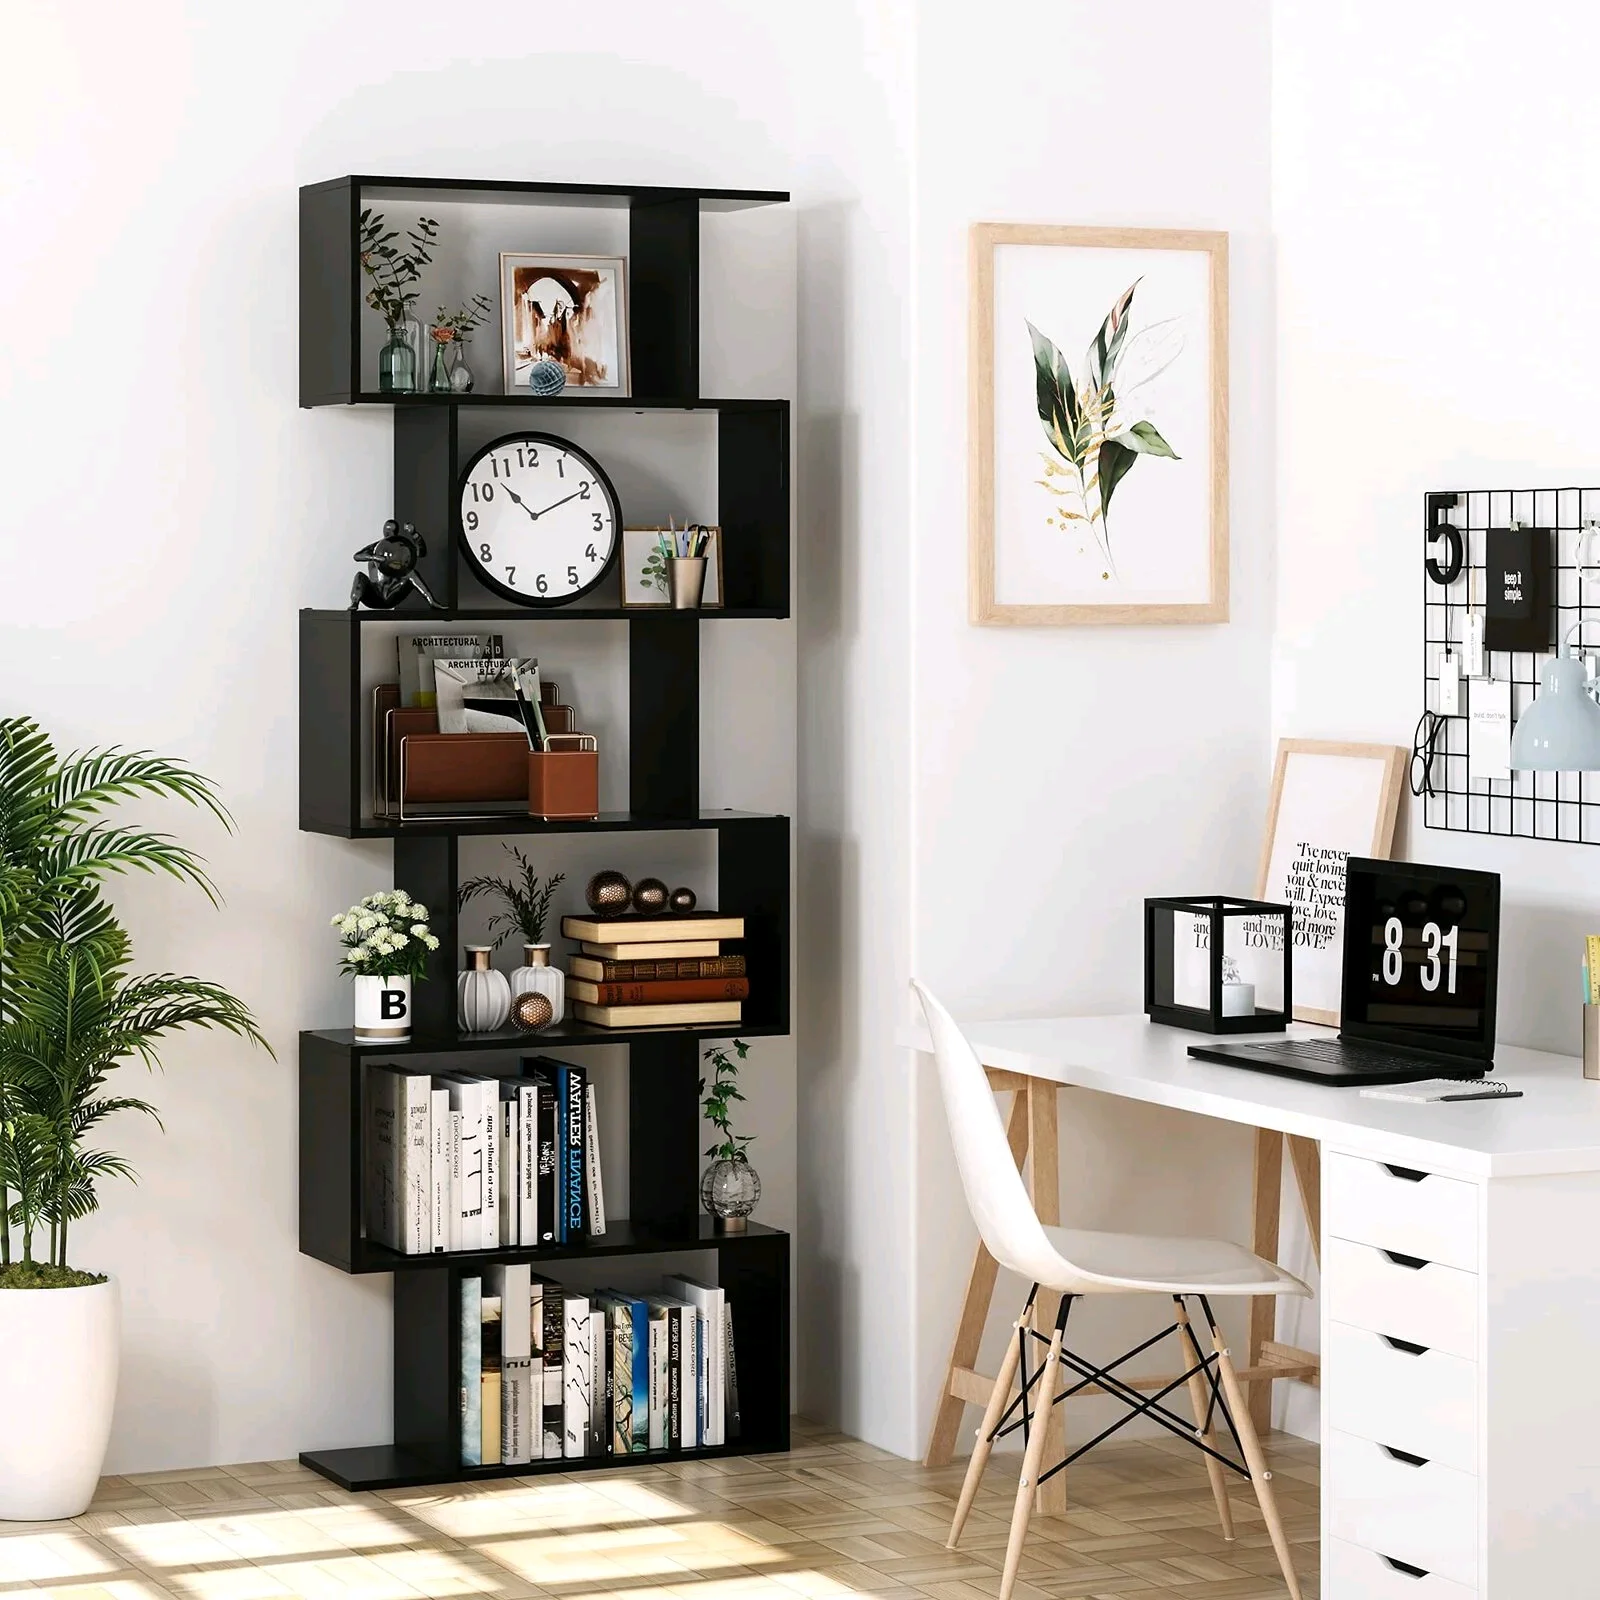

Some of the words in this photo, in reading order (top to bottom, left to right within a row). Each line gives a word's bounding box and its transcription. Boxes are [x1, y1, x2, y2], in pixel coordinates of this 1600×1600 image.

[517, 448, 539, 468] 12
[491, 458, 510, 478] 11
[557, 459, 564, 478] 1
[472, 483, 494, 502] 10
[579, 481, 590, 499] 2
[466, 511, 478, 530] 9
[592, 513, 603, 531] 3
[1426, 494, 1463, 585] 5
[480, 544, 492, 562] 8
[585, 544, 596, 562] 4
[506, 567, 516, 585] 7
[536, 574, 548, 593] 6
[567, 566, 578, 584] 5
[1504, 571, 1517, 588] keep
[412, 638, 480, 646] ARCHITECTURAL
[444, 646, 500, 654] REORD
[448, 661, 512, 669] ARCHITECTURA
[1320, 849, 1350, 861] never
[1292, 859, 1314, 874] quit
[1316, 860, 1346, 876] loving
[1286, 875, 1305, 888] you
[1307, 874, 1319, 888] &
[1320, 880, 1346, 891] neve
[1285, 887, 1306, 901] will.
[1314, 904, 1337, 922] love,
[1243, 920, 1262, 933] and
[1292, 918, 1306, 931] nd
[1308, 923, 1336, 936] more
[1292, 932, 1332, 950] OVE!”
[1383, 917, 1403, 986] 8
[1420, 922, 1458, 994] 31
[380, 990, 407, 1020] B
